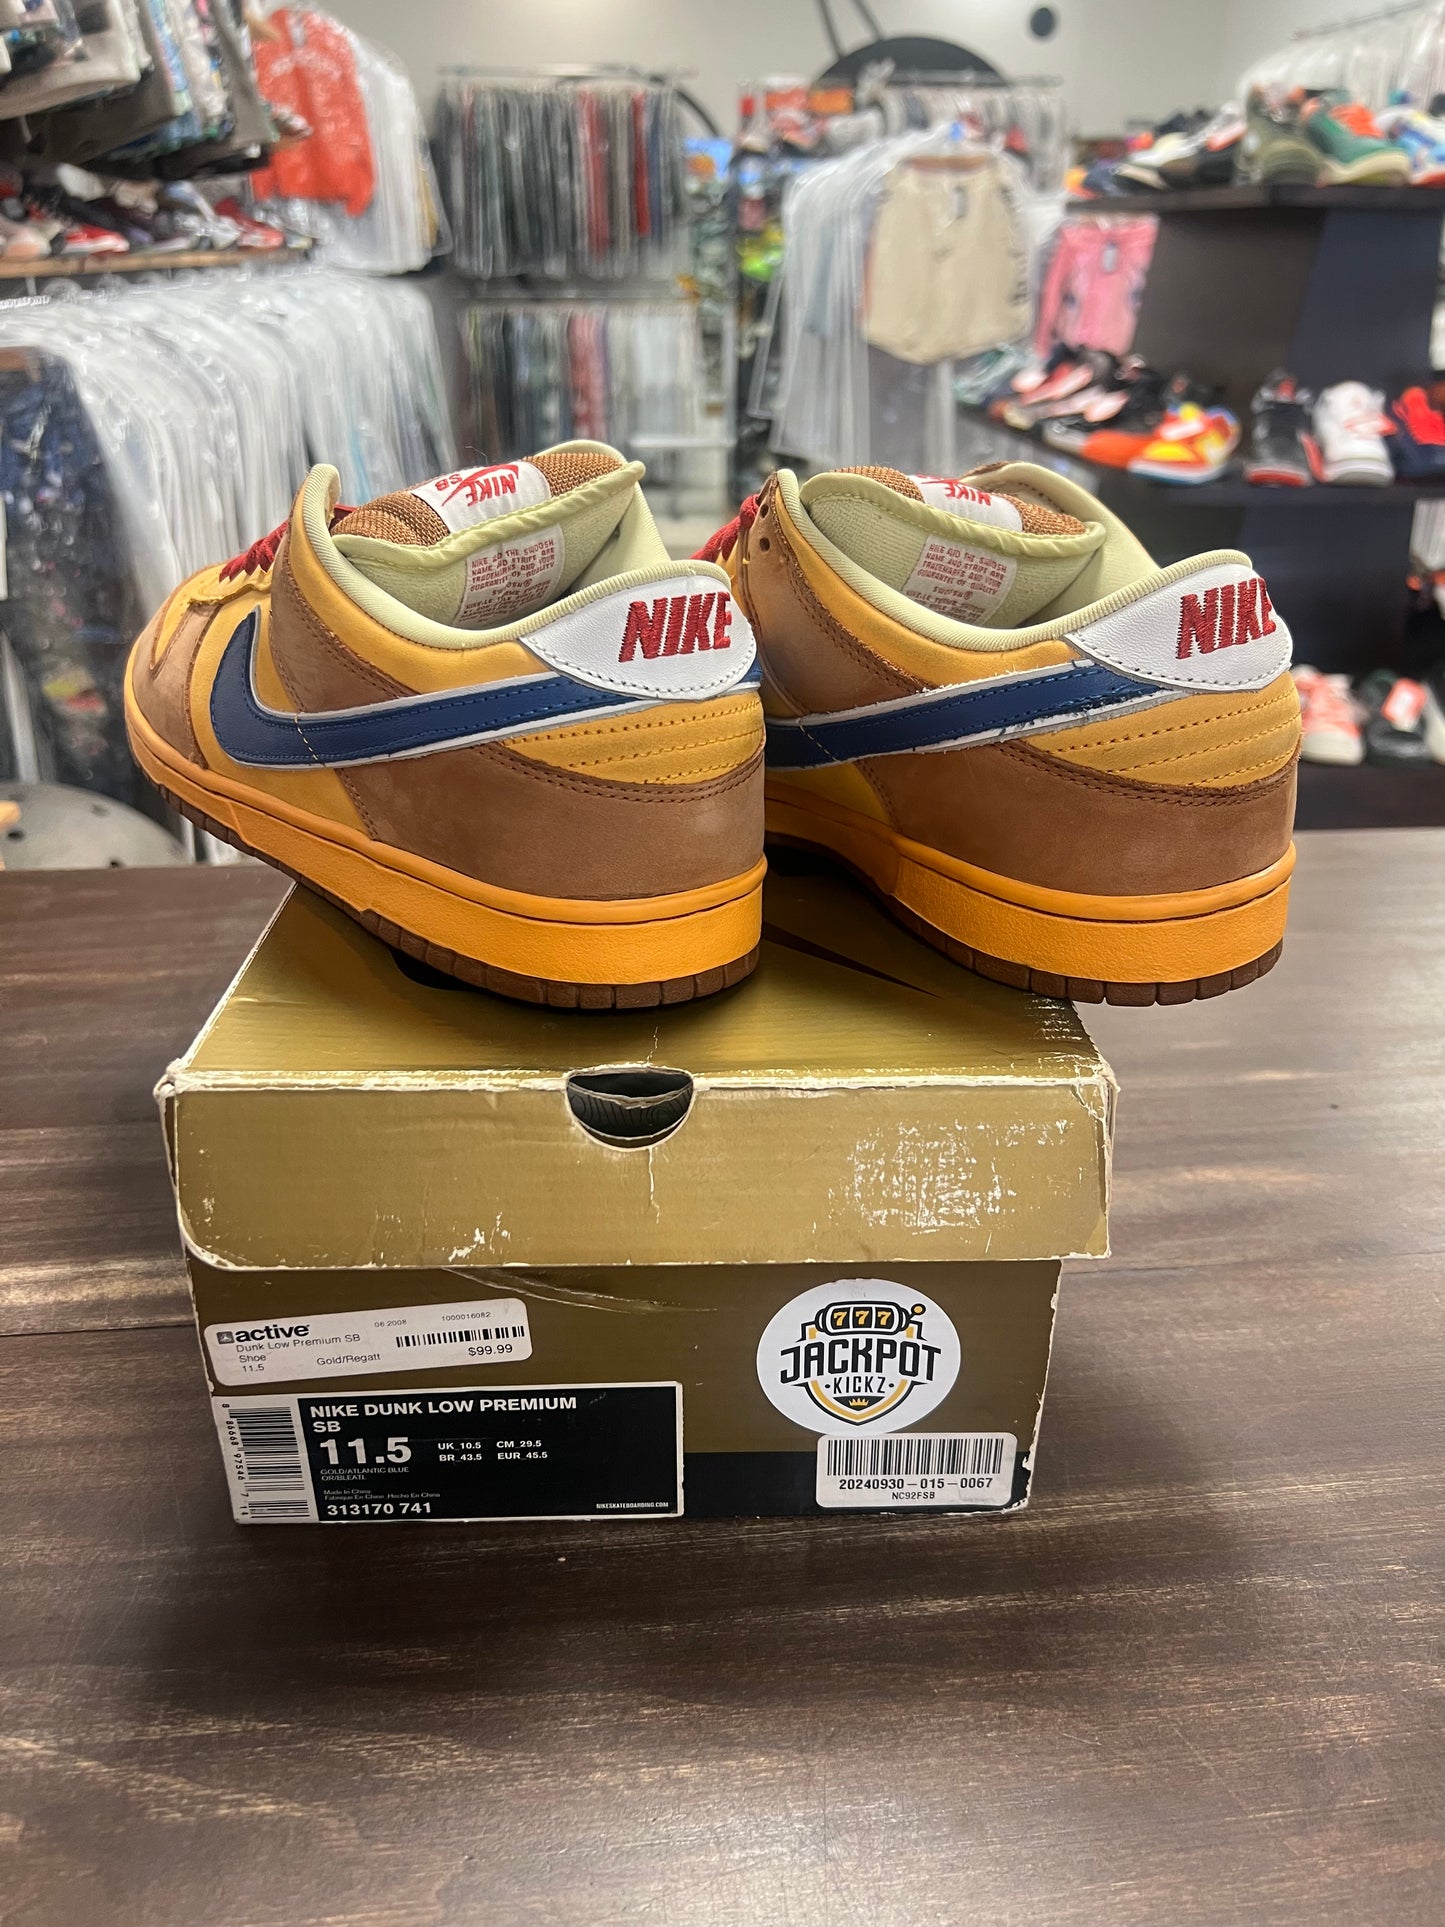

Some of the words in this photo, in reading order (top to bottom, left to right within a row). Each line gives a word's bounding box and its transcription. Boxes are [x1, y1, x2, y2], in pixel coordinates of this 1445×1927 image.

[434, 474, 462, 492] SB
[465, 474, 516, 508] NIKE
[944, 482, 992, 506] NIKE
[472, 557, 488, 568] NIKE
[505, 548, 520, 558] THE
[524, 540, 554, 556] SWOOSH
[472, 566, 492, 576] NAME
[521, 562, 536, 572] AND
[618, 591, 732, 662] NIKE
[1176, 576, 1276, 660] NIKE
[235, 1324, 310, 1342] active
[236, 1343, 264, 1353] Dunk
[268, 1340, 290, 1350] Low
[293, 1336, 342, 1347] Premium
[344, 1334, 360, 1342] SB
[468, 1344, 513, 1356] $99.99
[238, 1354, 266, 1363] Shoe
[316, 1353, 381, 1367] Gold/Regatt
[780, 1338, 942, 1384] JACKPOT
[242, 1364, 264, 1373] 11.5
[833, 1376, 886, 1394] KICKZ
[310, 1404, 359, 1418] NIKE
[364, 1402, 422, 1416] DUNK
[428, 1400, 474, 1414] LOW
[480, 1396, 577, 1412] PREMIUM
[312, 1421, 341, 1433] SB
[320, 1436, 412, 1465] 11.5
[892, 1492, 936, 1500] NC92FSB
[327, 1503, 394, 1516] 313170
[399, 1502, 432, 1514] 741
